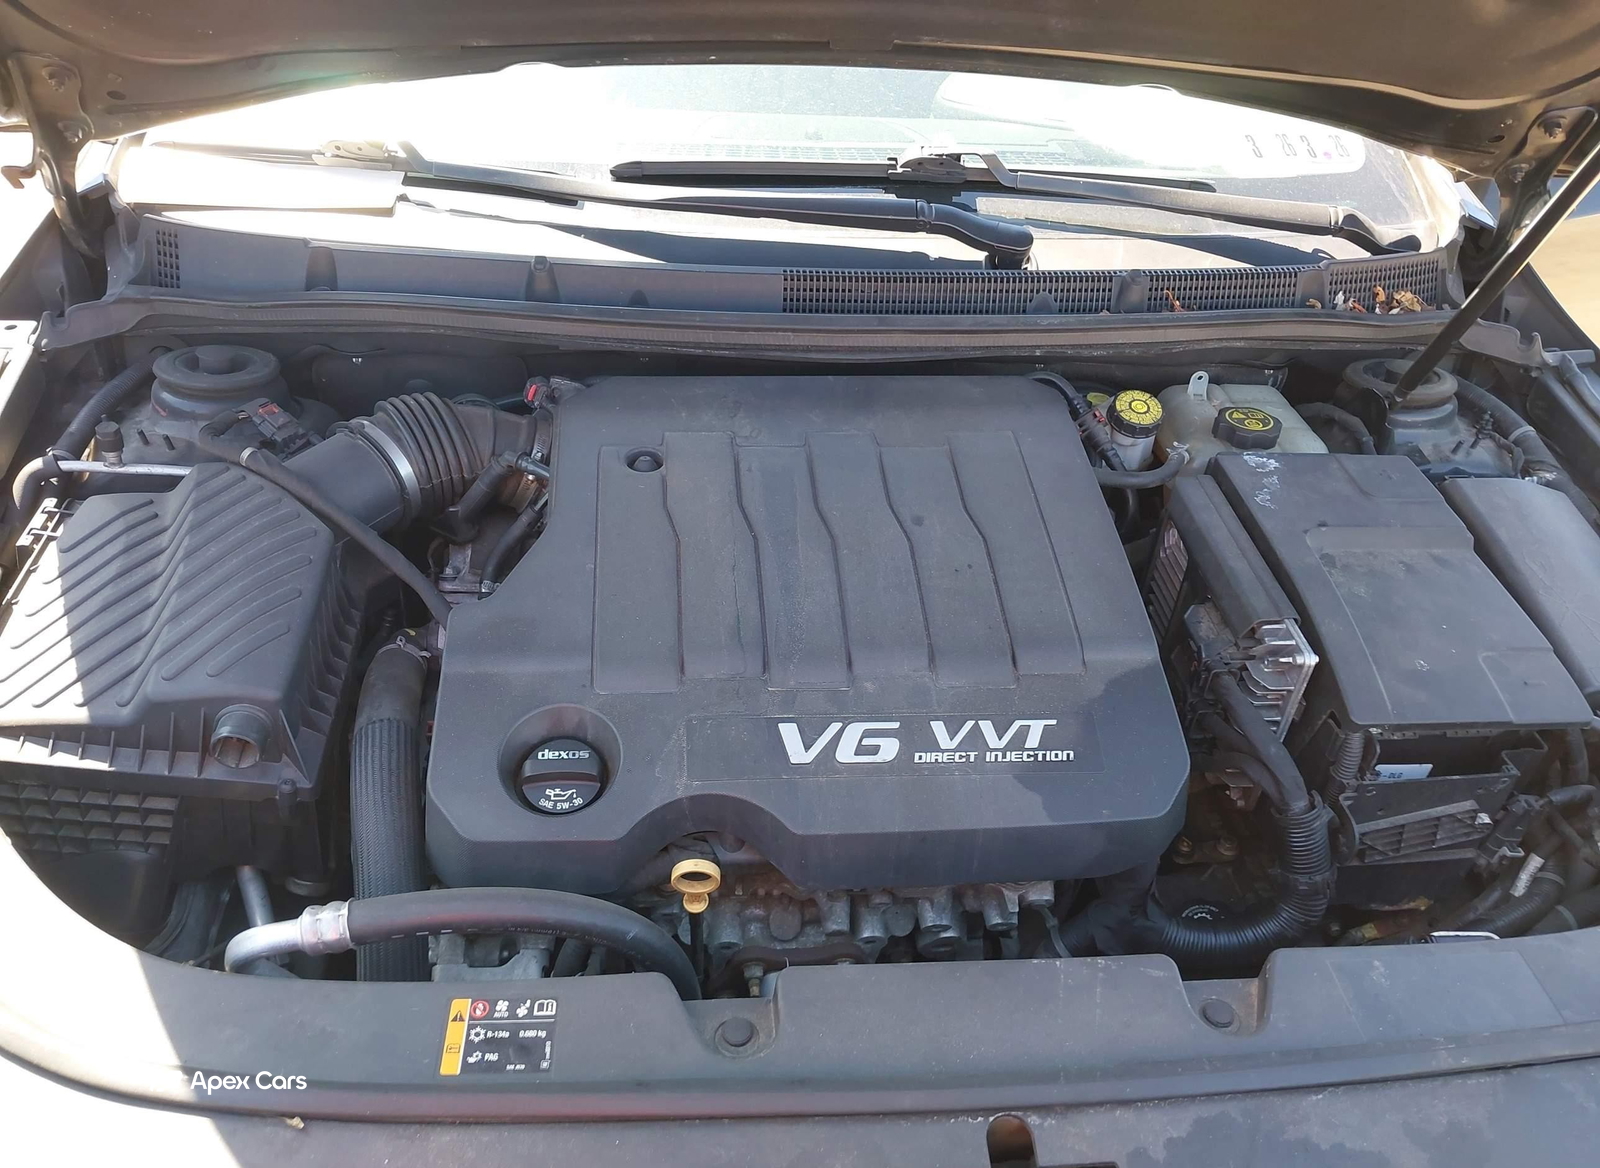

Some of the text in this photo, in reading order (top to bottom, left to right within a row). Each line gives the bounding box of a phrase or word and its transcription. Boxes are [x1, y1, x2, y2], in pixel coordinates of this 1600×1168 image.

[1245, 133, 1298, 158] 3 26
[1300, 135, 1317, 158] 3
[777, 719, 1058, 764] V6 VVT
[537, 748, 591, 760] dexos
[913, 750, 1075, 763] DIRECT INJECTION
[538, 797, 584, 810] SAE 5W-30
[486, 1030, 510, 1039] R-134a
[538, 1029, 547, 1039] kg
[484, 1053, 499, 1061] PAG
